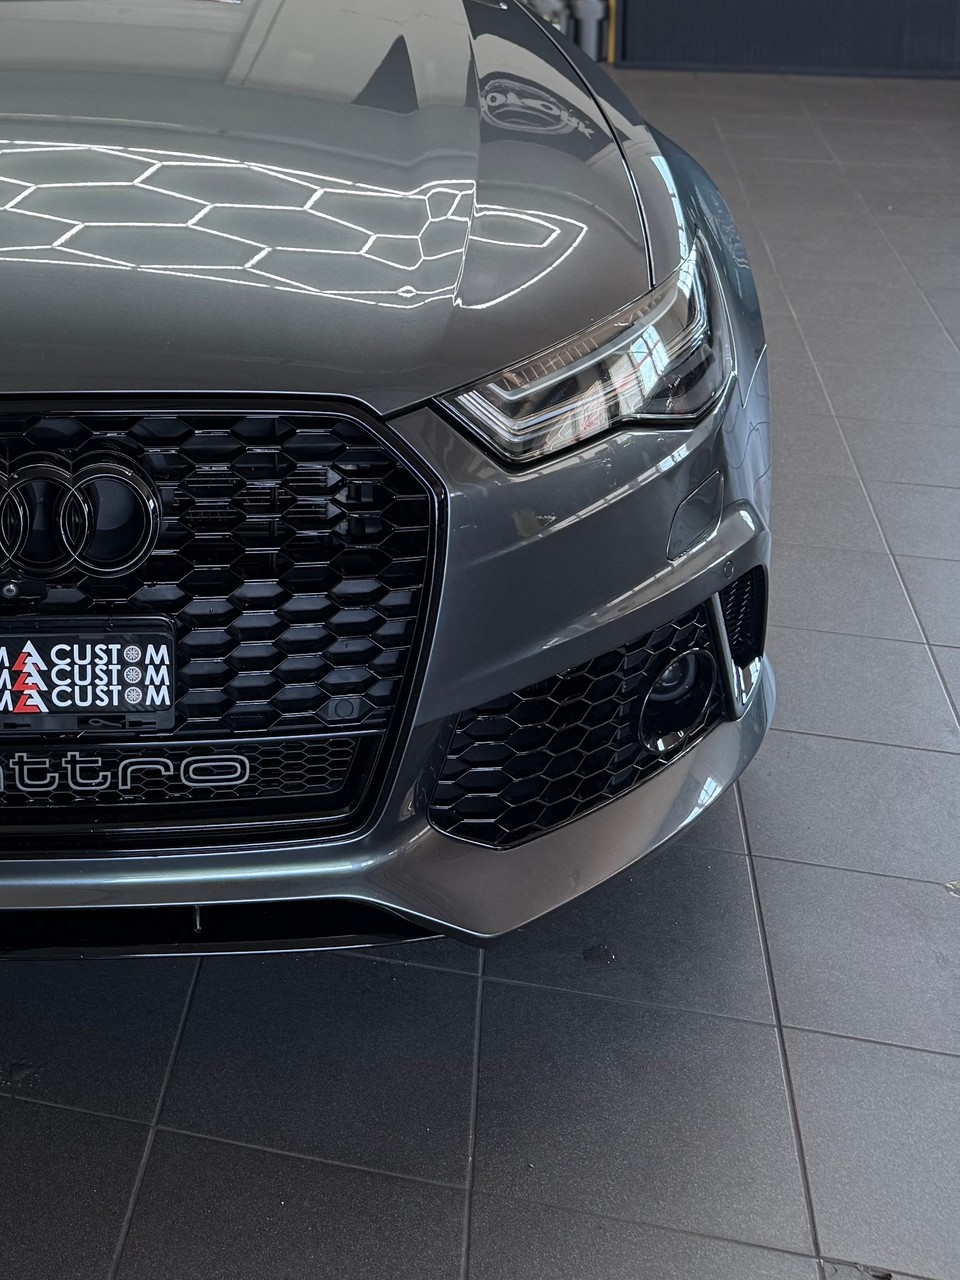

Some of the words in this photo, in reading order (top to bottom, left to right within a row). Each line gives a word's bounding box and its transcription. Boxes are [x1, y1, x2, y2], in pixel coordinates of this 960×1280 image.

[50, 643, 171, 666] CUSTOM
[51, 664, 171, 687] CUSTOM
[51, 685, 172, 708] CUSTOM
